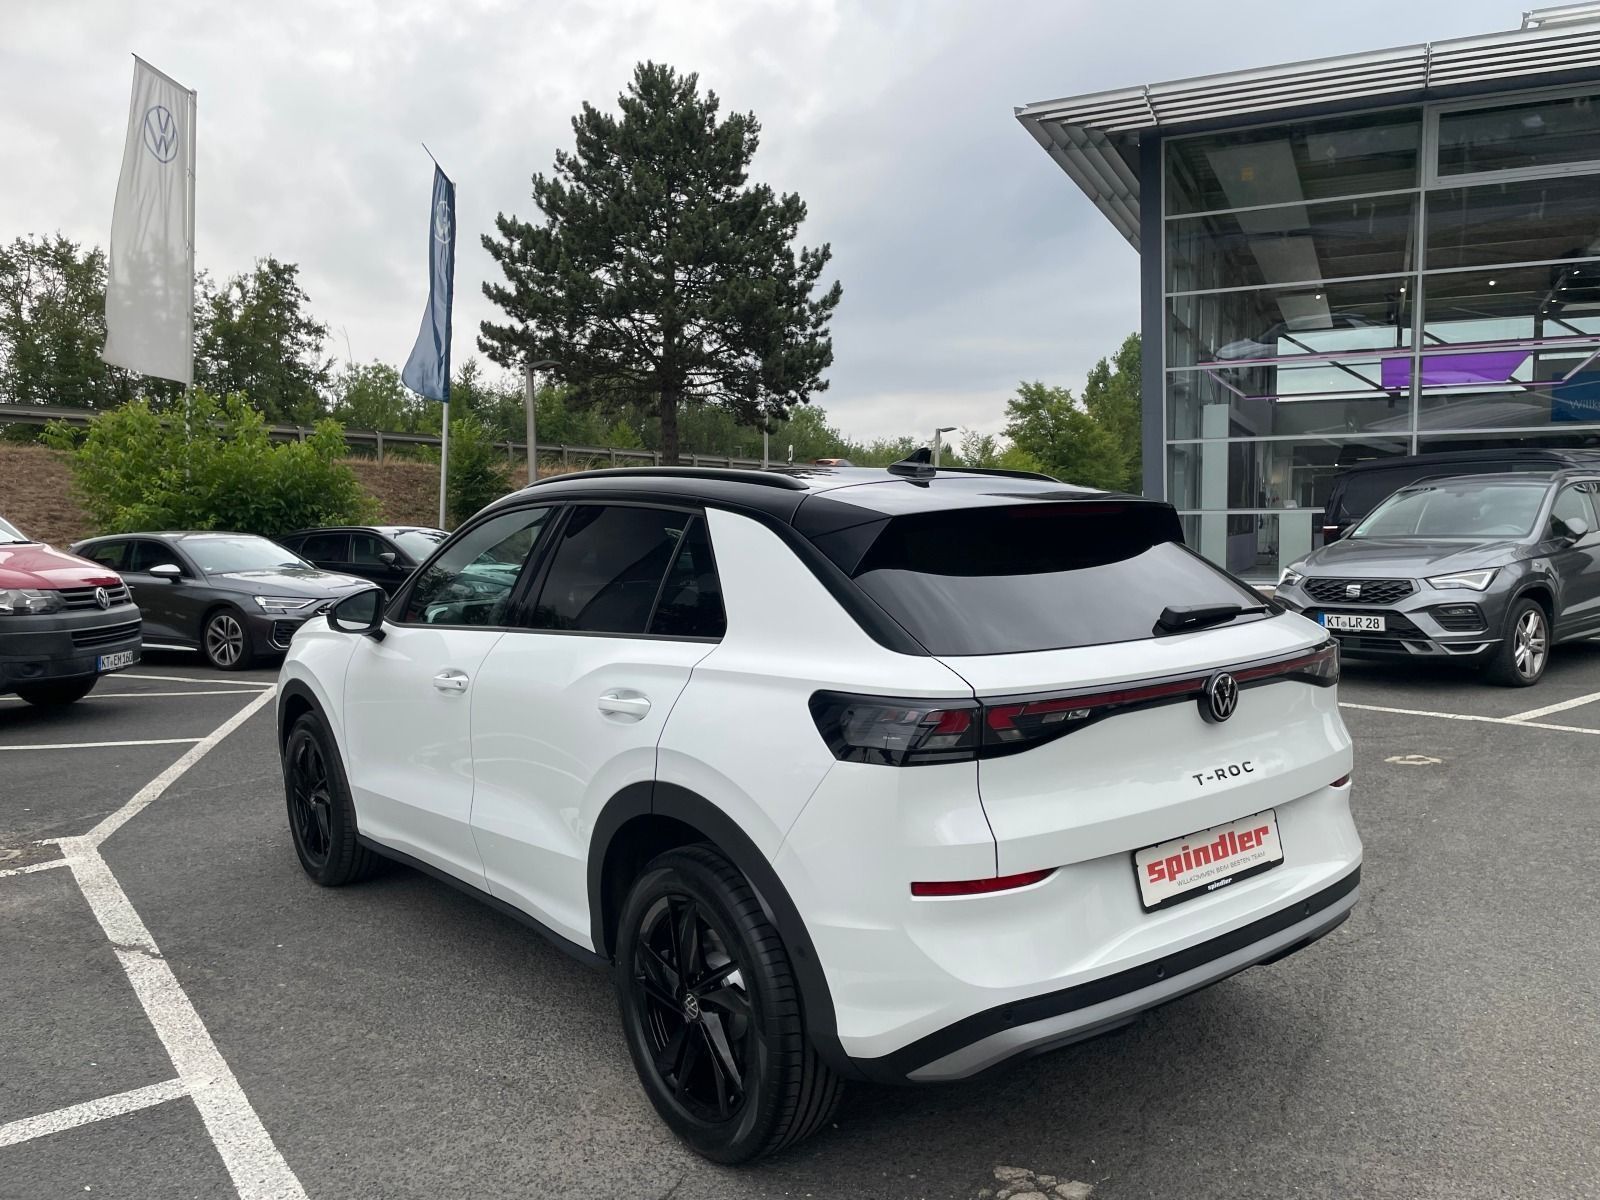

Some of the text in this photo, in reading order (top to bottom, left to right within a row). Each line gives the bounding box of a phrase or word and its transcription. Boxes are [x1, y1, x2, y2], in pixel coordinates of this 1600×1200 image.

[1327, 615, 1379, 629] KT LR 28
[1192, 761, 1254, 786] T-ROC
[1146, 825, 1270, 884] spindler
[1176, 851, 1266, 887] WILLKOMMEN BEIM BESTEN TEAM
[1207, 877, 1233, 891] spindler
